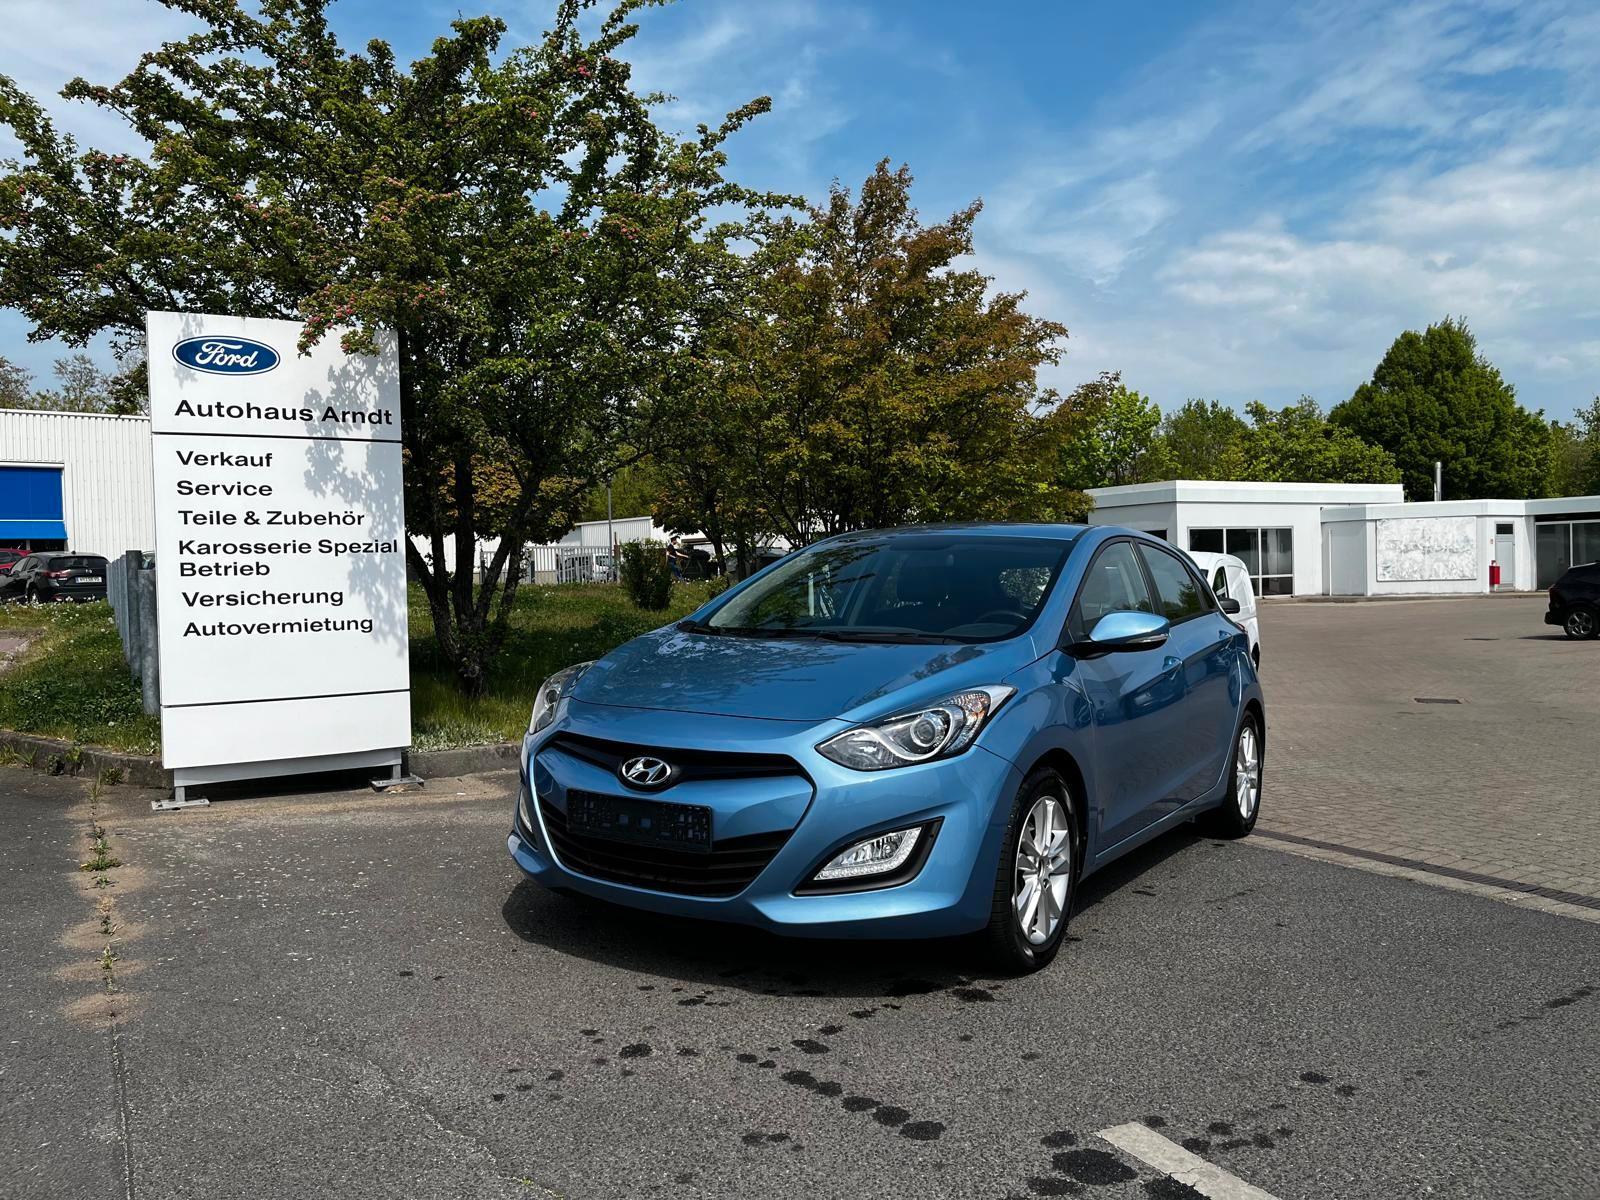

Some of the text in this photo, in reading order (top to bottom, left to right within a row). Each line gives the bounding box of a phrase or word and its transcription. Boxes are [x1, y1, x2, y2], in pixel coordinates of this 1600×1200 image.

[195, 341, 258, 368] Ford
[175, 399, 393, 425] Autohaus Arndt
[176, 450, 273, 467] Verkauf
[176, 480, 273, 496] Service
[178, 510, 365, 526] Teile & Zubehör
[178, 539, 398, 556] Karosserie Spezial
[179, 562, 271, 577] Betrieb
[182, 590, 344, 607] Versicherung
[183, 617, 373, 637] Autovermietung
